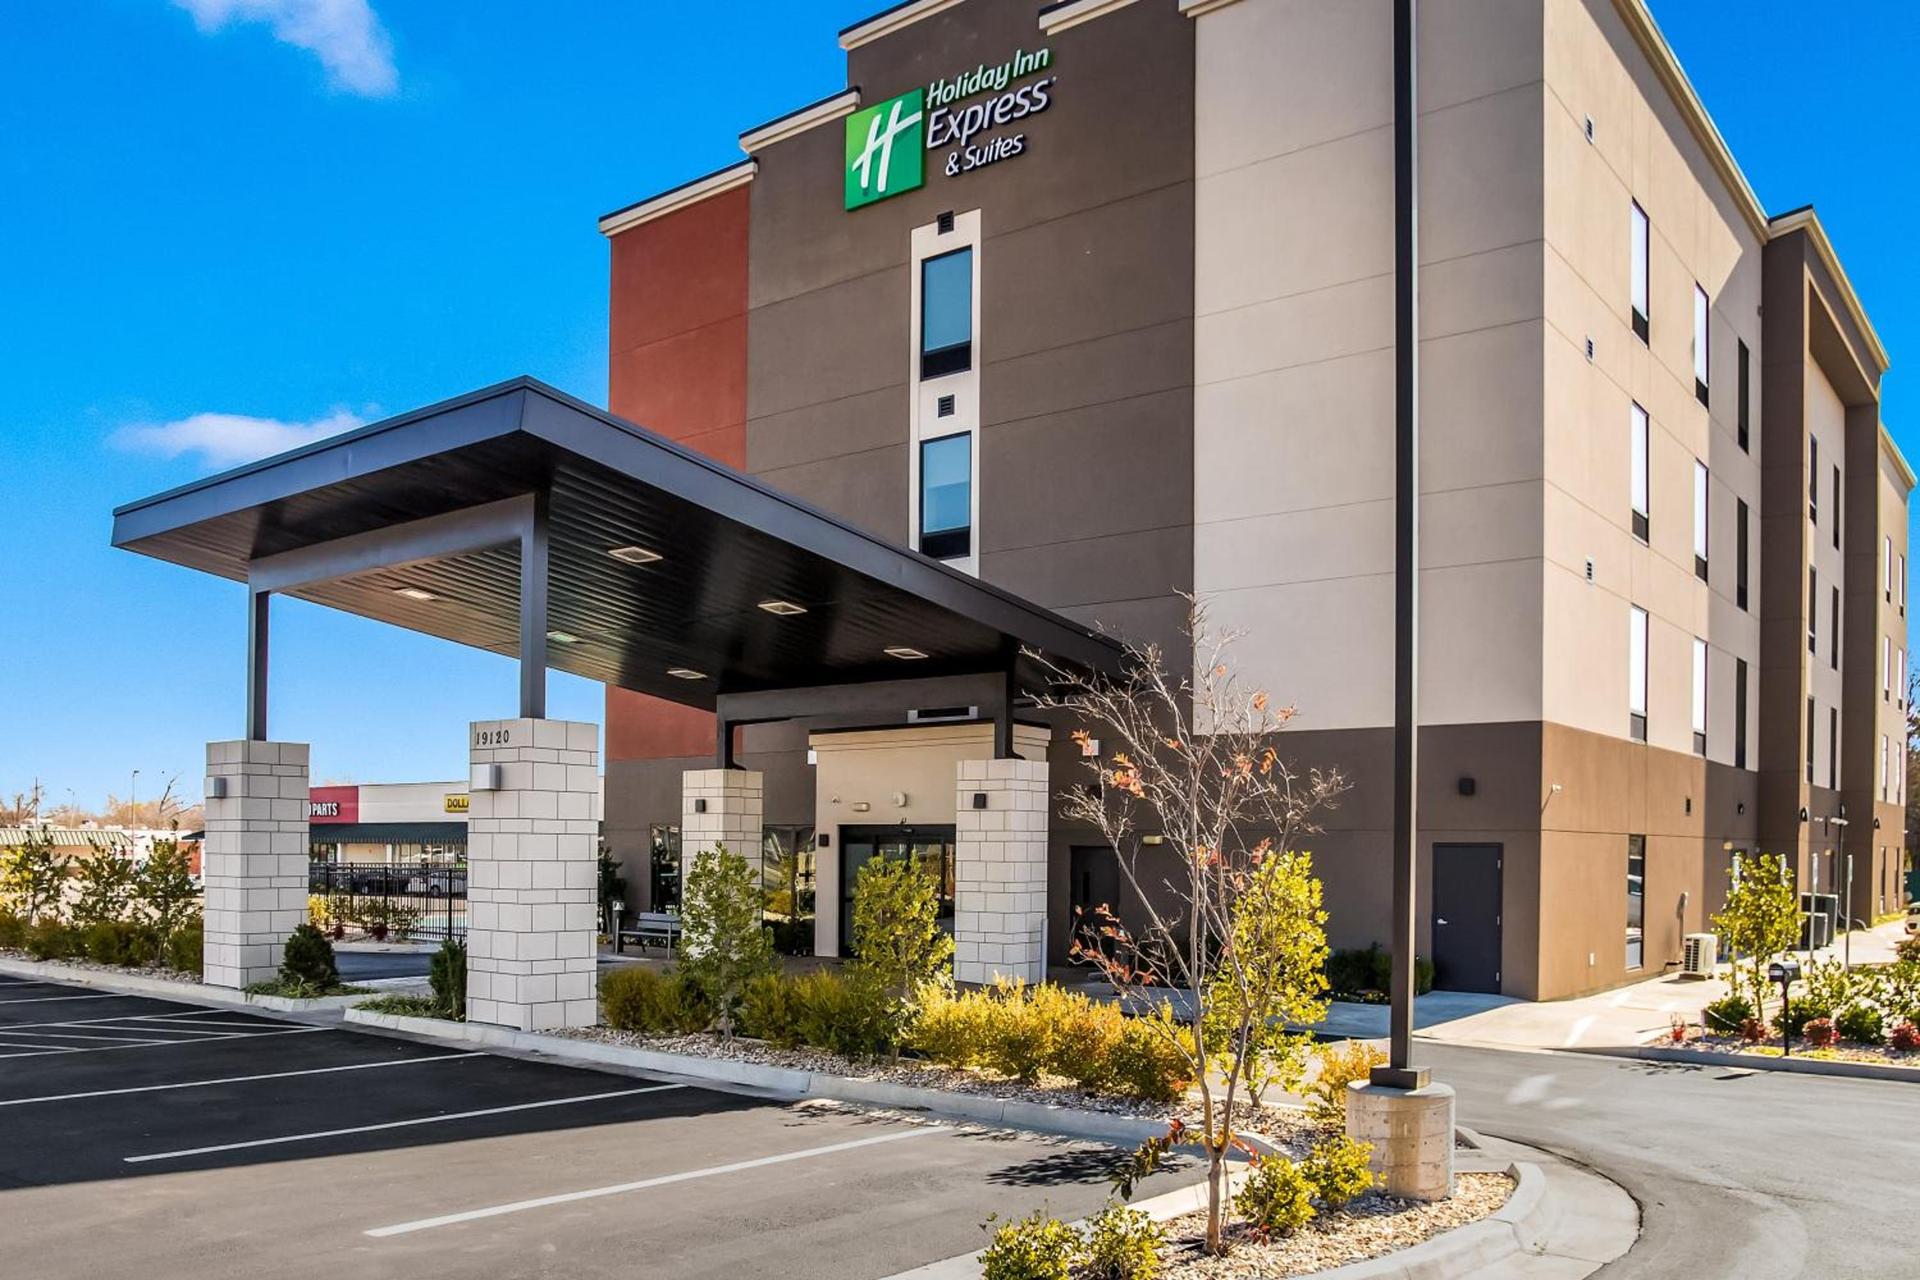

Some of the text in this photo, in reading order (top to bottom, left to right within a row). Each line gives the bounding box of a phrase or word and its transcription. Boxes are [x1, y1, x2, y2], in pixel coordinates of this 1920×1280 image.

[926, 48, 1049, 109] Holiday Inn
[926, 79, 1050, 149] Express
[945, 134, 1024, 176] & Suites
[476, 729, 509, 745] 19120
[312, 803, 338, 816] PARTS
